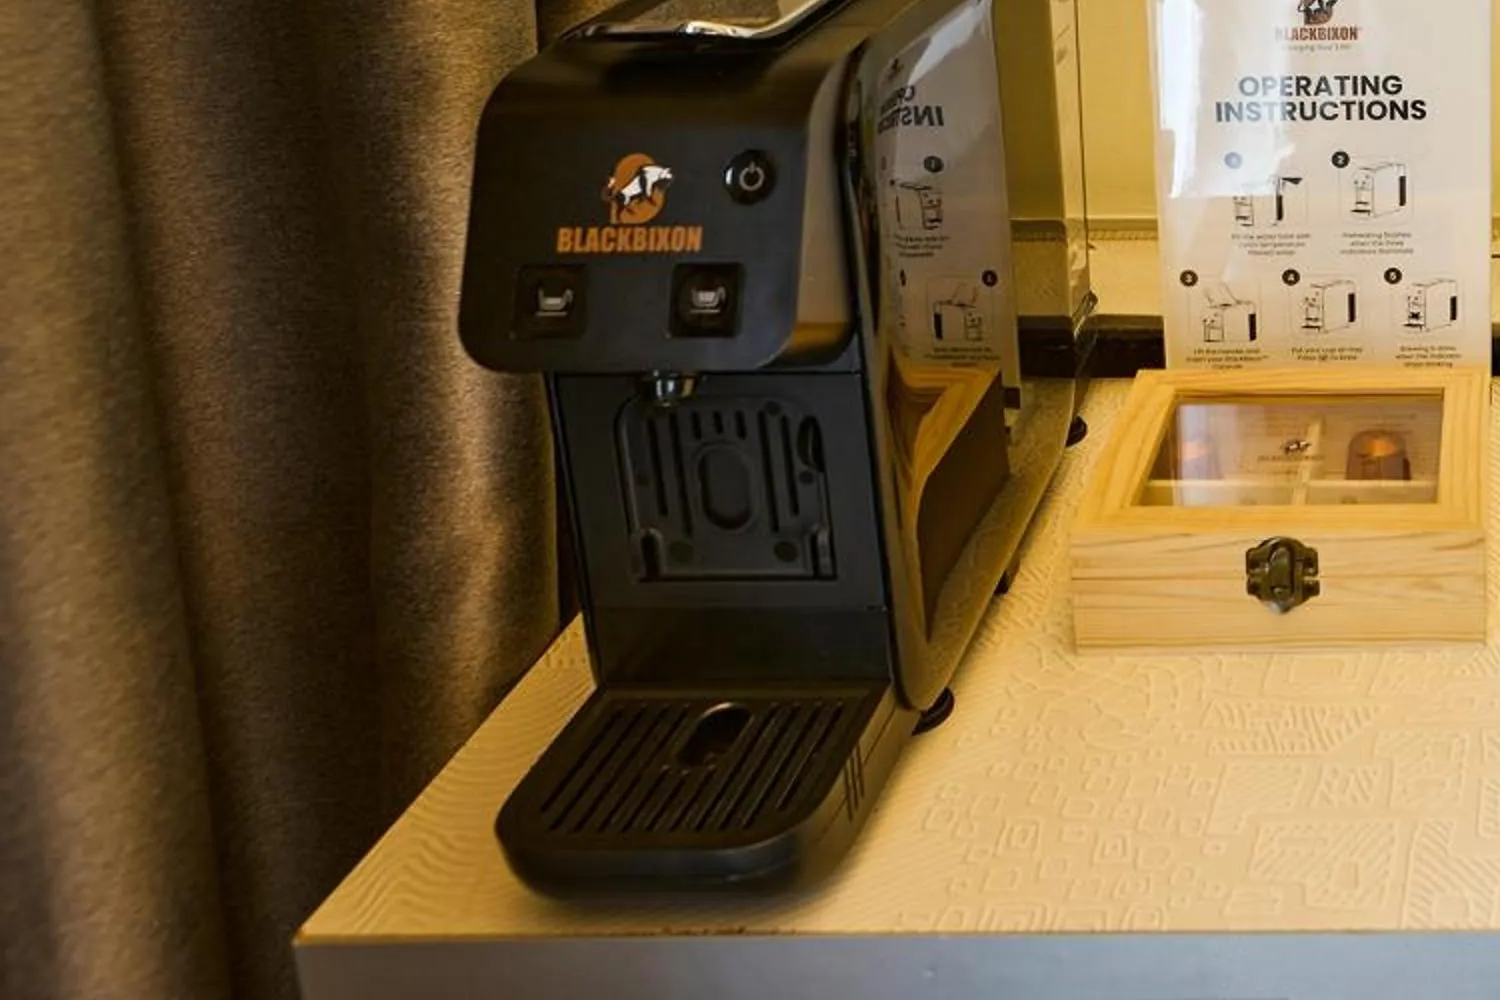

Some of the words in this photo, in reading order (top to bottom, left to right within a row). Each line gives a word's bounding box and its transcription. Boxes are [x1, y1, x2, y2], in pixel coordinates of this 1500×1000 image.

[1238, 75, 1403, 97] OPERATING
[1215, 100, 1427, 122] INSTRUCTIONS
[557, 226, 703, 253] BLACKBIXON
